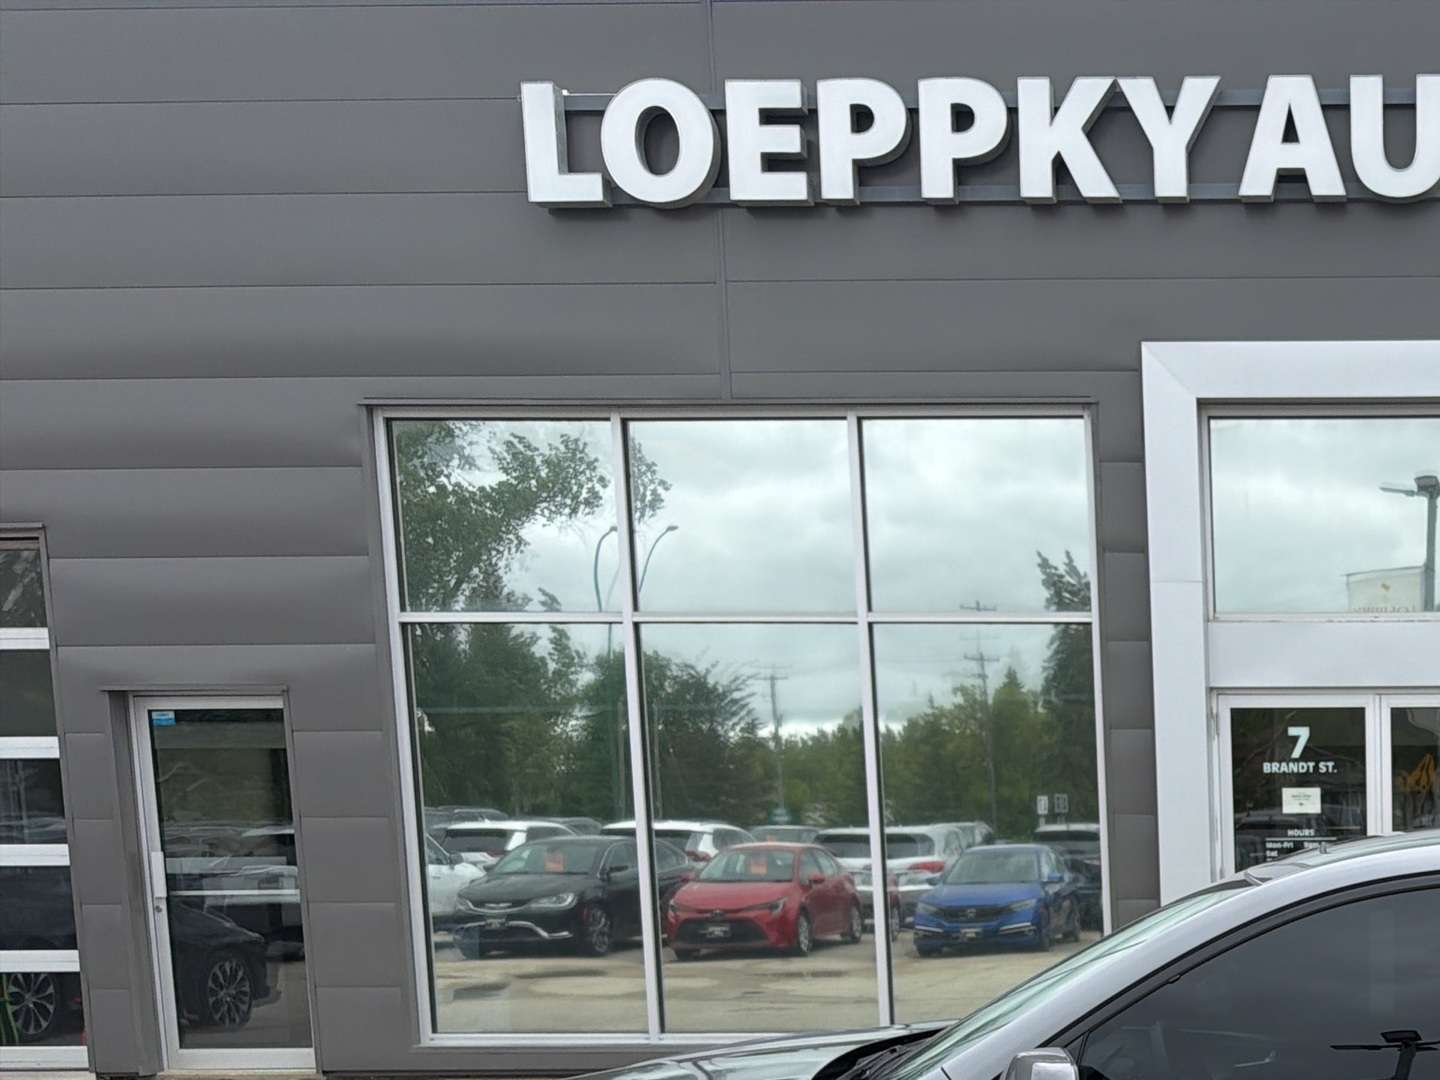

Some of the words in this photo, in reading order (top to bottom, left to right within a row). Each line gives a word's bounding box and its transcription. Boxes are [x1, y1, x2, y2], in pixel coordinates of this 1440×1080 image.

[521, 75, 1221, 206] LOEPPKY
[1287, 726, 1310, 759] 7
[1263, 761, 1315, 773] BRANDT
[1318, 761, 1338, 773] ST.
